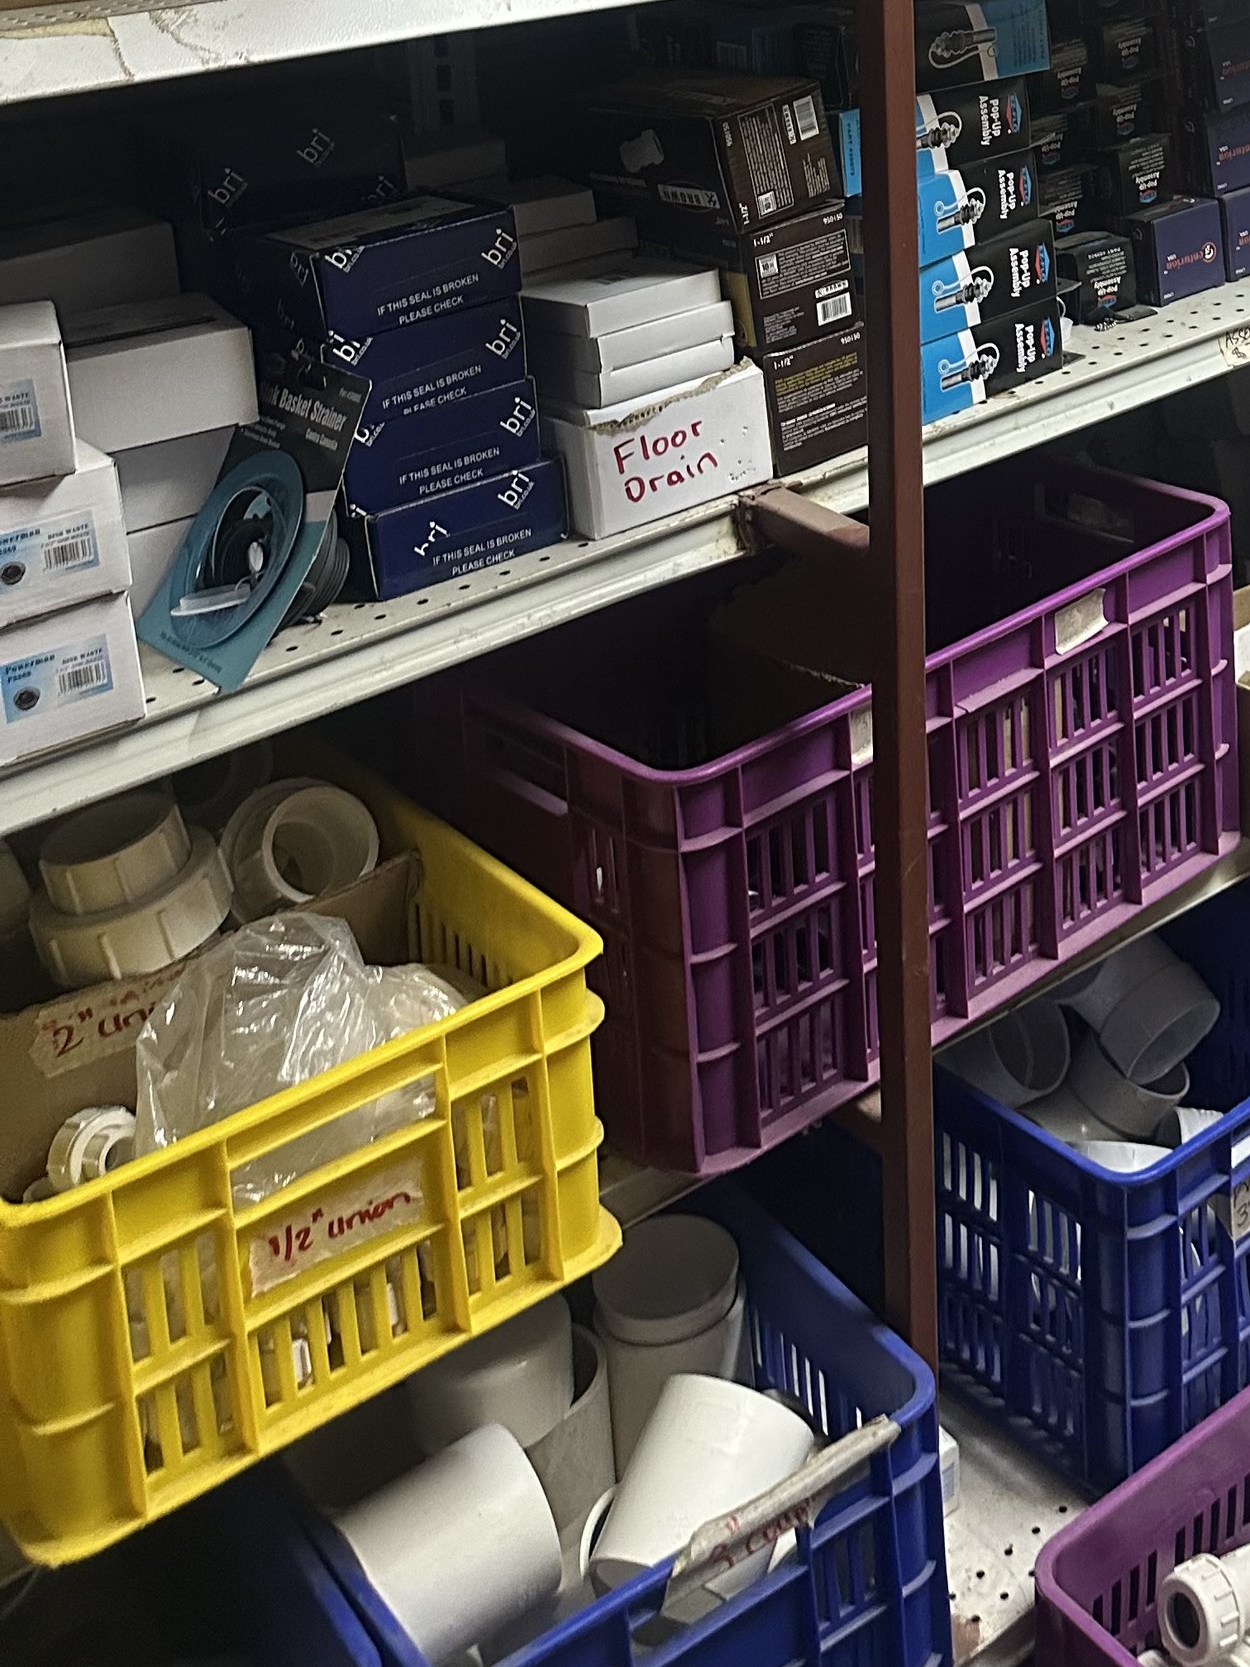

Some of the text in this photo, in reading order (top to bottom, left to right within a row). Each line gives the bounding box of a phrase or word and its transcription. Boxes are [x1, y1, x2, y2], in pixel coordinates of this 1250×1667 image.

[979, 95, 991, 146] Assembly
[991, 98, 1002, 138] Pop-Up
[297, 128, 332, 164] bri
[207, 167, 245, 205] bri
[998, 169, 1008, 220] Assembly
[1006, 171, 1017, 210] Pop-Up
[481, 227, 514, 266] bri
[1009, 247, 1021, 298] Assembly
[1020, 249, 1031, 290] Pop-Up
[1093, 276, 1122, 290] Assembly
[377, 273, 479, 316] IF THIS SEAL IS BROKEN
[1097, 284, 1119, 296] Pop-Up
[399, 295, 464, 325] PLEASE CHECK
[485, 318, 519, 357] bri
[1015, 323, 1026, 374] Assembly
[1025, 324, 1036, 363] Pop-Up
[382, 365, 482, 410] IF THIS SEAL IS BROKEN
[438, 386, 467, 405] CHECK
[279, 387, 313, 420] Basket
[310, 400, 348, 432] Strainer
[499, 396, 533, 435] bri
[399, 446, 500, 485] IF THIS SEAL IS BROKEN
[613, 420, 703, 475] Floor
[419, 468, 484, 495] PLEASE CHECK
[497, 470, 531, 507] bri
[624, 451, 718, 503] Drain
[432, 527, 532, 566] IF THIS SEAL IS BROKEN
[452, 549, 516, 576] PLEASE CHECK
